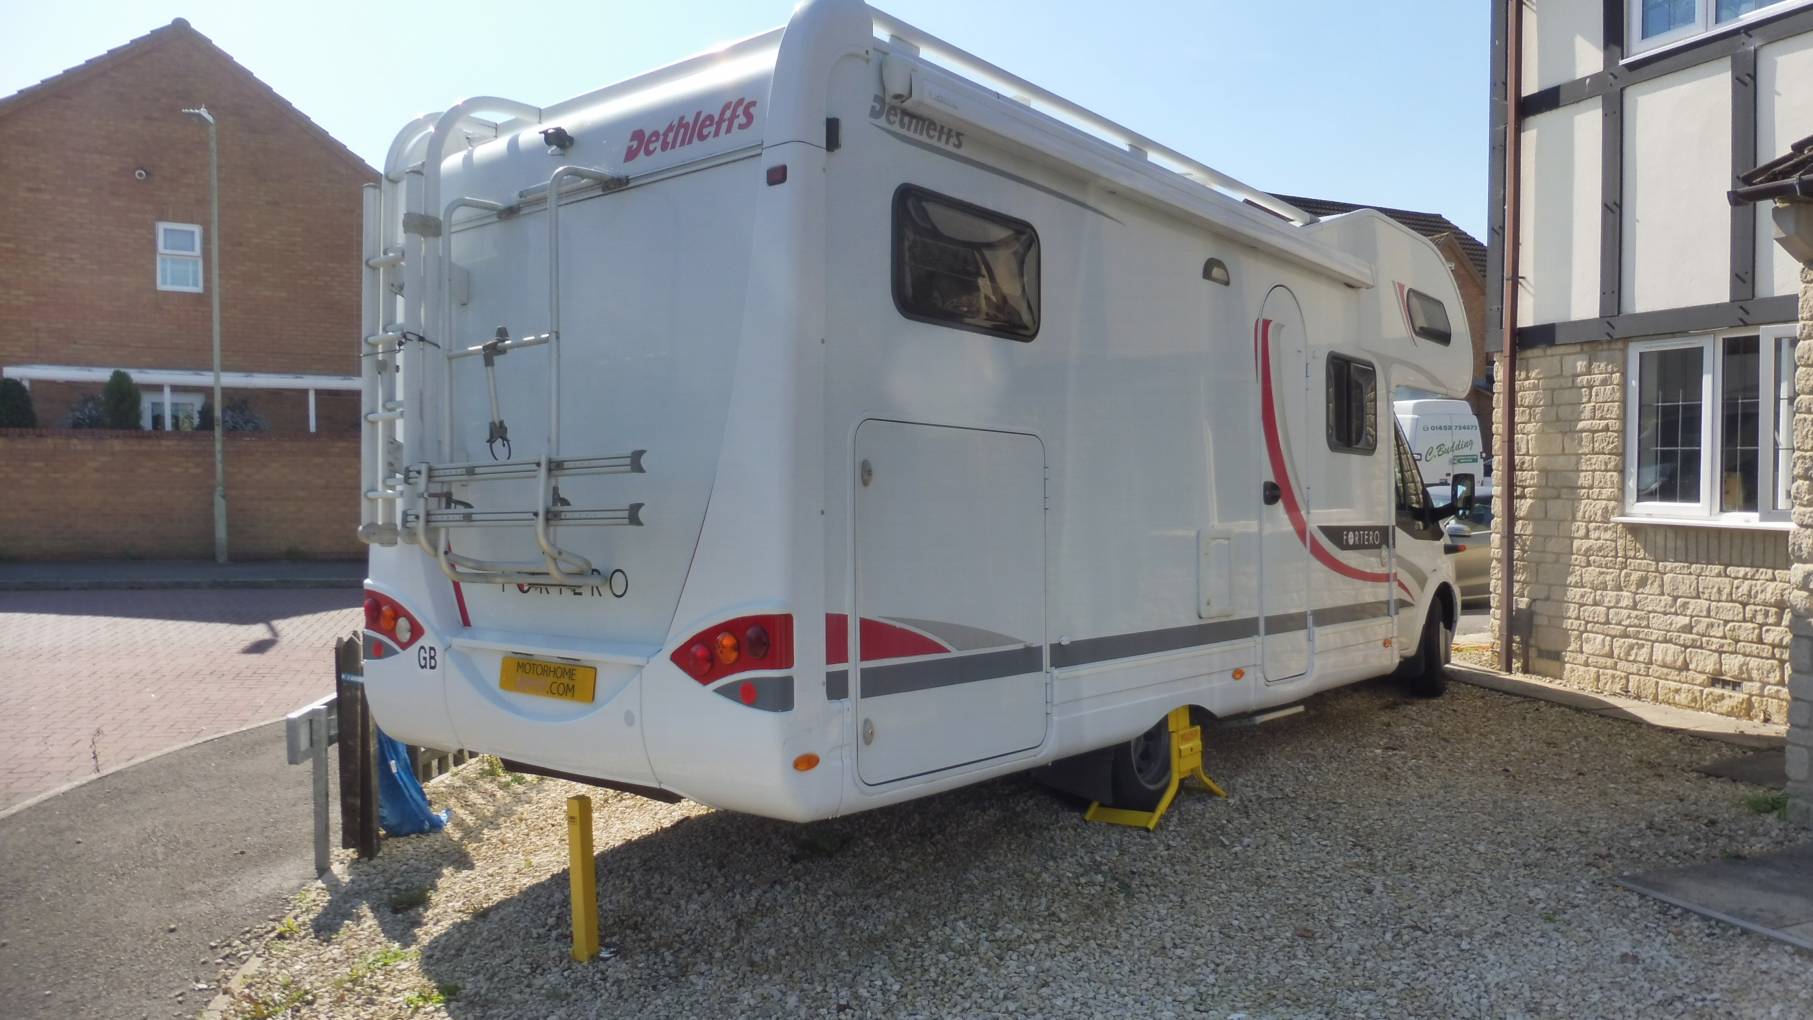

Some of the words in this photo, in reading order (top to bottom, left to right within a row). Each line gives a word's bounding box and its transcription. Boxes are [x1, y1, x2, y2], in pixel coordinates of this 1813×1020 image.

[623, 97, 757, 163] Dethleffs
[1343, 530, 1381, 545] FORTERO
[418, 645, 437, 670] GB
[516, 661, 577, 681] MOTORHOME
[546, 681, 575, 698] .COM
